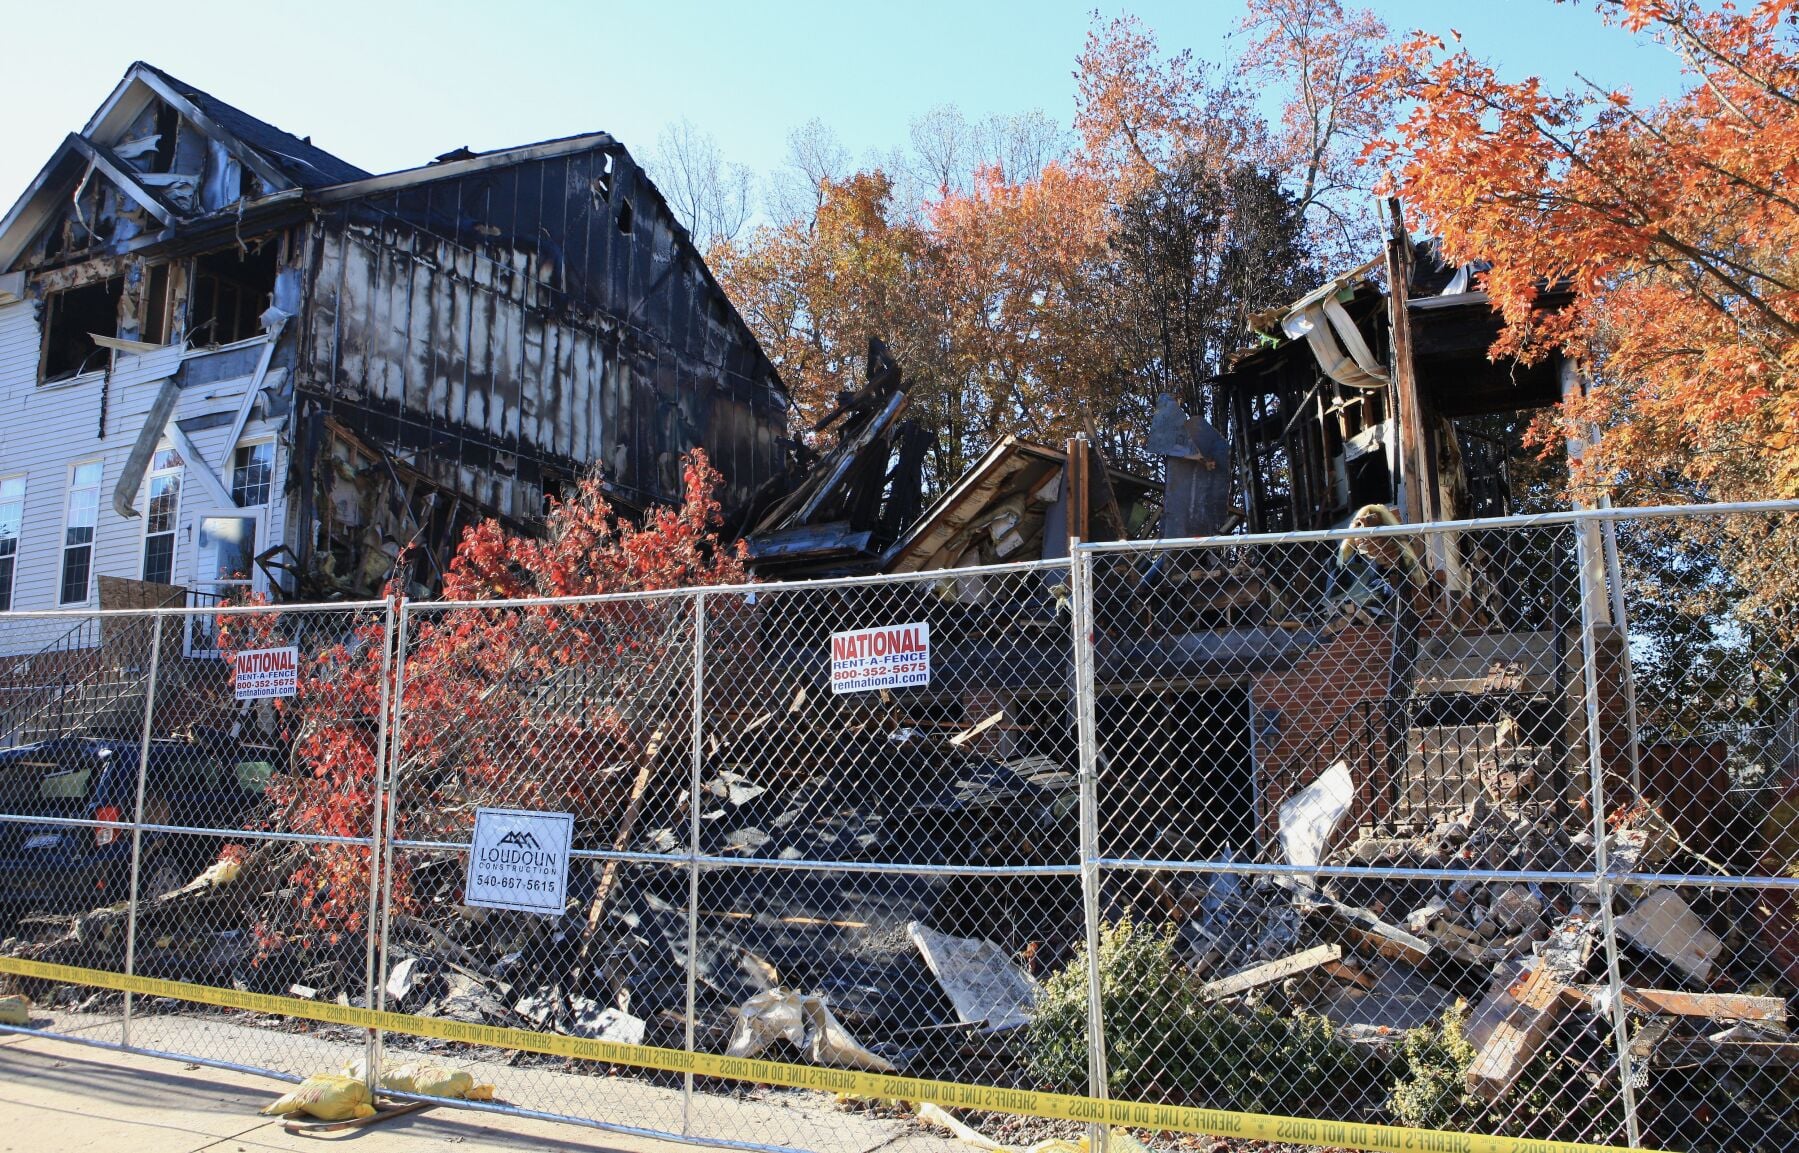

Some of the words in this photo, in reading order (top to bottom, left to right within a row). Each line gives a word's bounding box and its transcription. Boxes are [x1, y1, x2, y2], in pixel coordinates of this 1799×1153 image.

[833, 628, 926, 661] NATIONAL
[238, 651, 295, 674] NATIONAL
[833, 651, 927, 670] RENT-A-FENCE
[237, 670, 295, 681] RENT-A-FENCE
[834, 662, 926, 680] 800-352-5675
[237, 678, 294, 689] 800-352-5675
[833, 673, 927, 691] rentnational.com
[237, 686, 294, 697] rentnational.com
[480, 847, 557, 867] LOUDOUN
[479, 862, 557, 875] CONSTRUCTION
